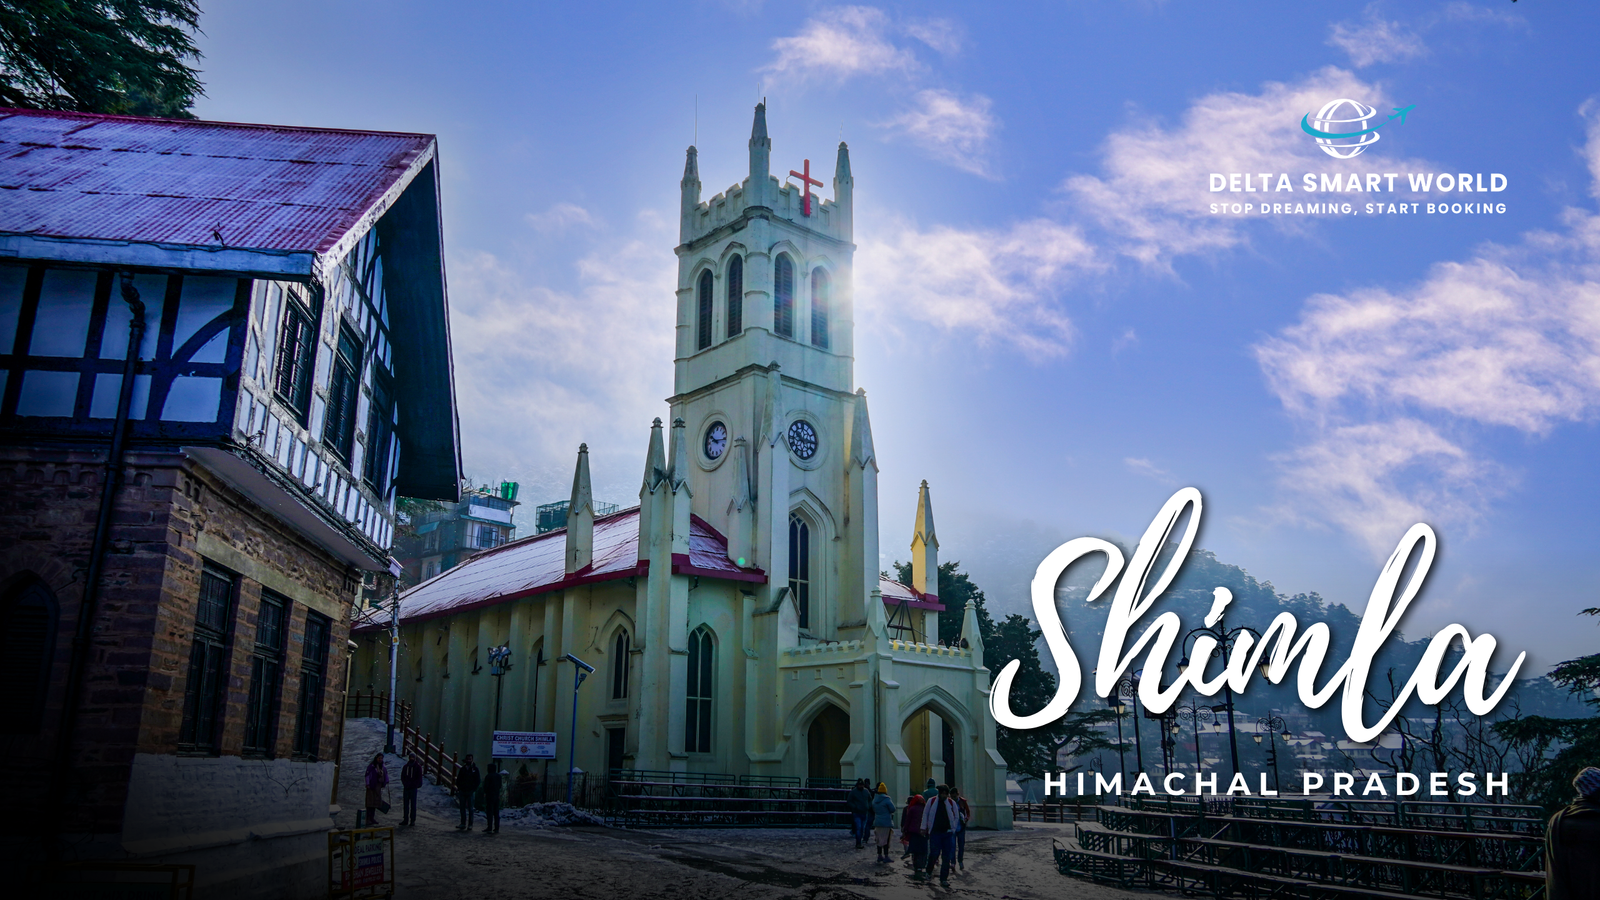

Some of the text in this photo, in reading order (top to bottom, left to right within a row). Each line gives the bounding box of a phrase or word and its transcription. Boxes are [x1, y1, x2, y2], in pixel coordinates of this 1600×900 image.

[52, 890, 165, 900] DO NOT MIX DRINK
